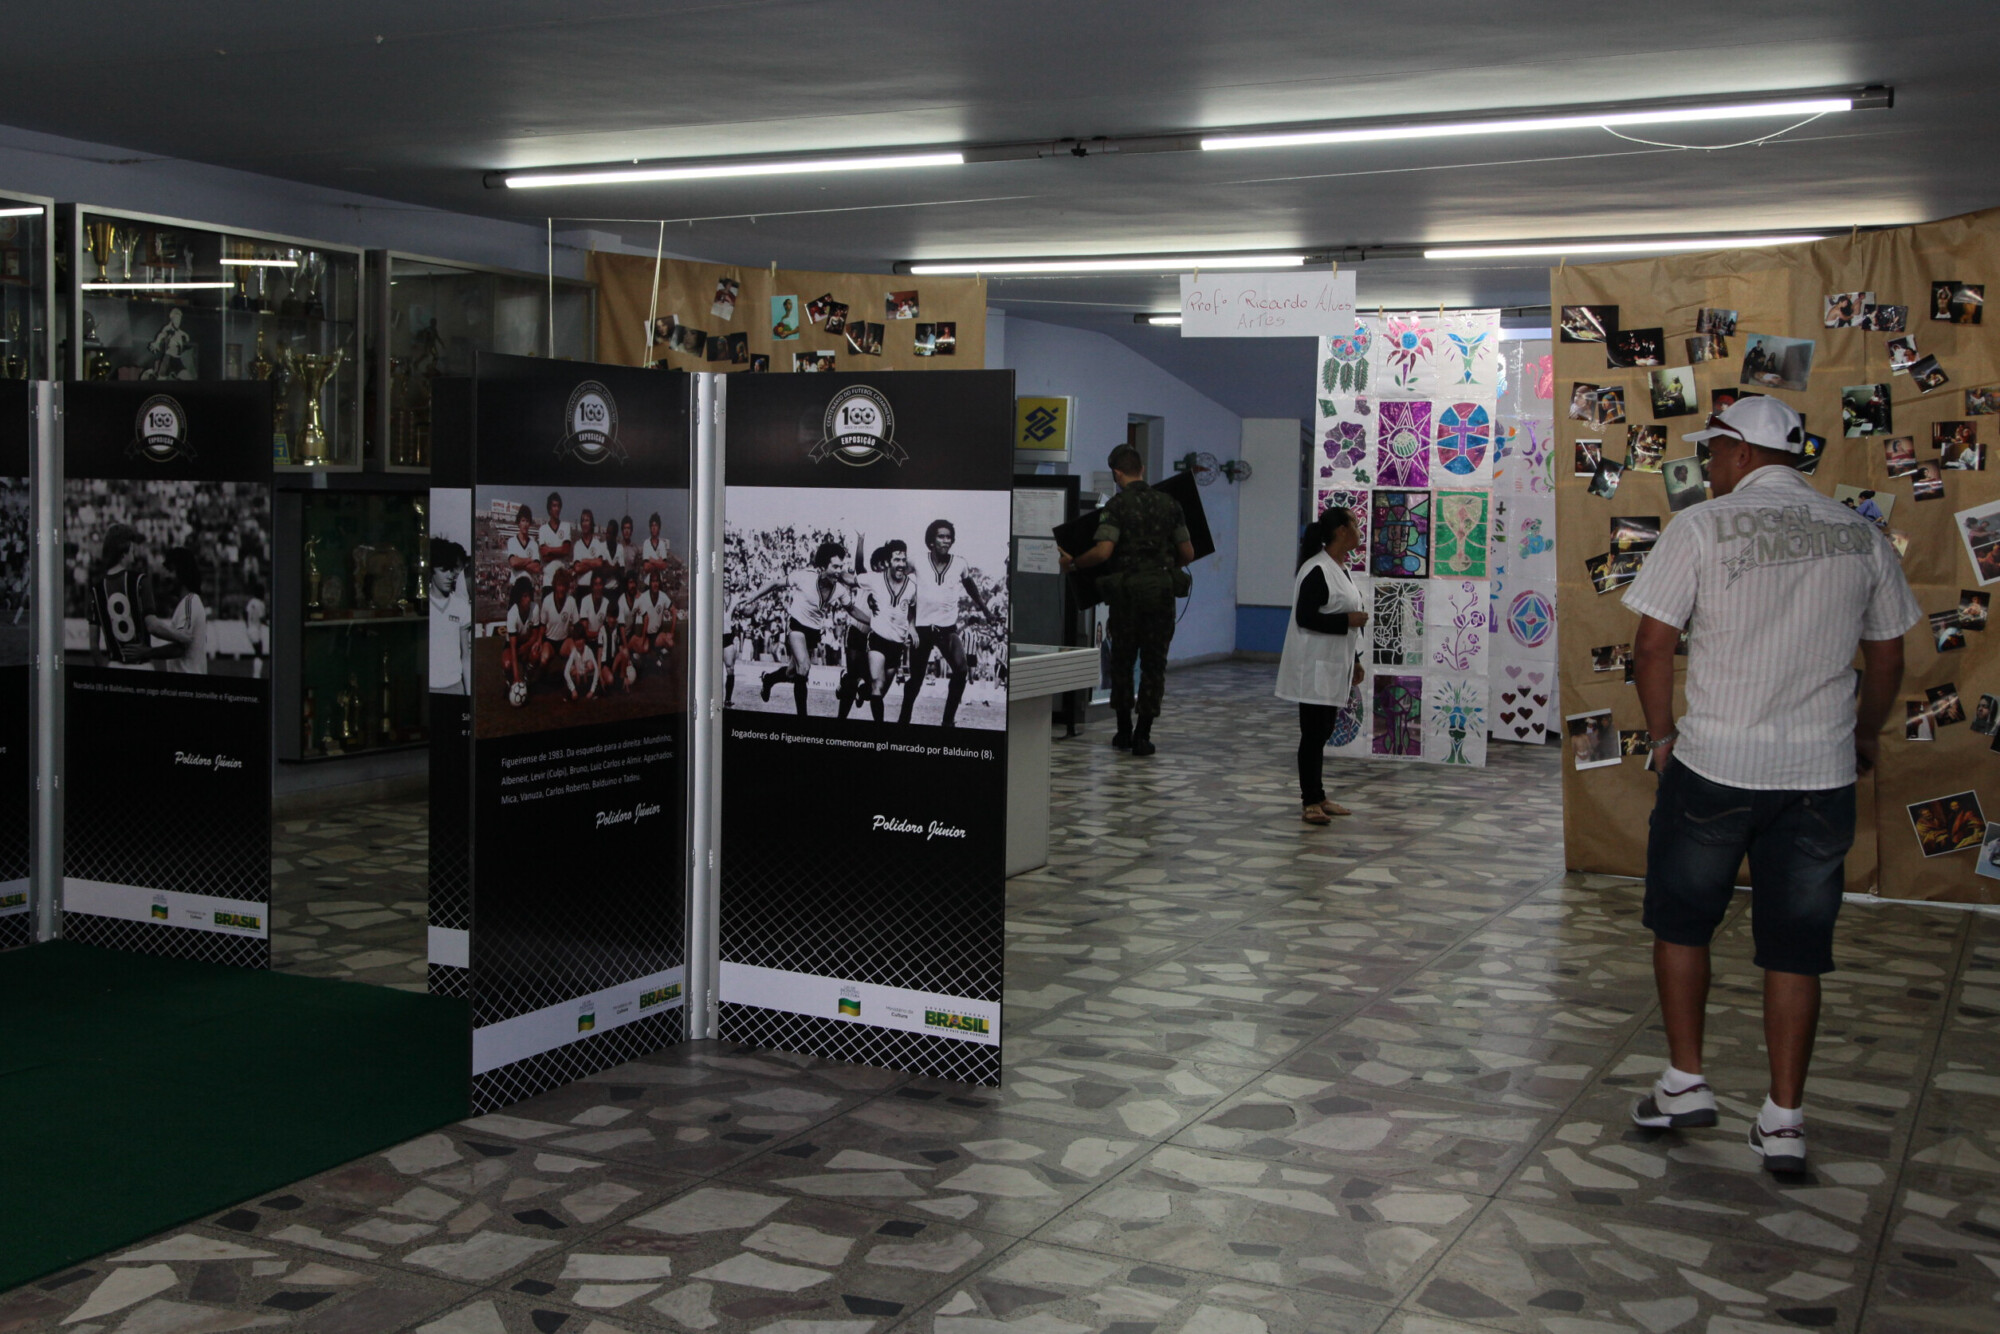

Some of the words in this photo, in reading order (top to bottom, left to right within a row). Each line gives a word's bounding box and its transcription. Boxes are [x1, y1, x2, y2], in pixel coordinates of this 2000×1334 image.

[1238, 289, 1308, 310] Ricardo
[1315, 284, 1351, 312] Alves
[852, 388, 873, 396] FUTEBOL
[841, 435, 876, 446] EXPOSIÇÃO
[1715, 504, 1812, 544] LOCAL
[1758, 520, 1873, 562] MOTION
[107, 592, 136, 642] 8
[501, 754, 538, 769] Figueirense
[538, 752, 547, 761] de
[548, 749, 565, 760] 1983.
[566, 748, 575, 757] Da
[575, 745, 603, 757] esquerda
[604, 742, 617, 752] para
[731, 728, 768, 740] Jogadores
[769, 732, 780, 741] do
[781, 732, 824, 744] Figueirense
[825, 738, 875, 749] comemoram
[876, 741, 889, 752] gol
[890, 743, 925, 754] marcado
[926, 747, 941, 756] por
[980, 749, 995, 761] (8).
[174, 750, 212, 766] Polidoro
[213, 753, 243, 771] Júnior
[570, 765, 590, 775] Bruno,
[590, 762, 602, 771] Luiz
[602, 757, 621, 769] Carlos
[545, 786, 564, 797] Carlos
[565, 782, 591, 793] Roberto,
[596, 809, 632, 830] Polidoro
[634, 802, 661, 824] Júnior
[872, 814, 924, 834] Polidoro
[926, 820, 967, 841] Júnior
[214, 911, 260, 929] BRASIL
[640, 983, 681, 1009] BRASIL
[924, 1010, 990, 1034] BRASIL
